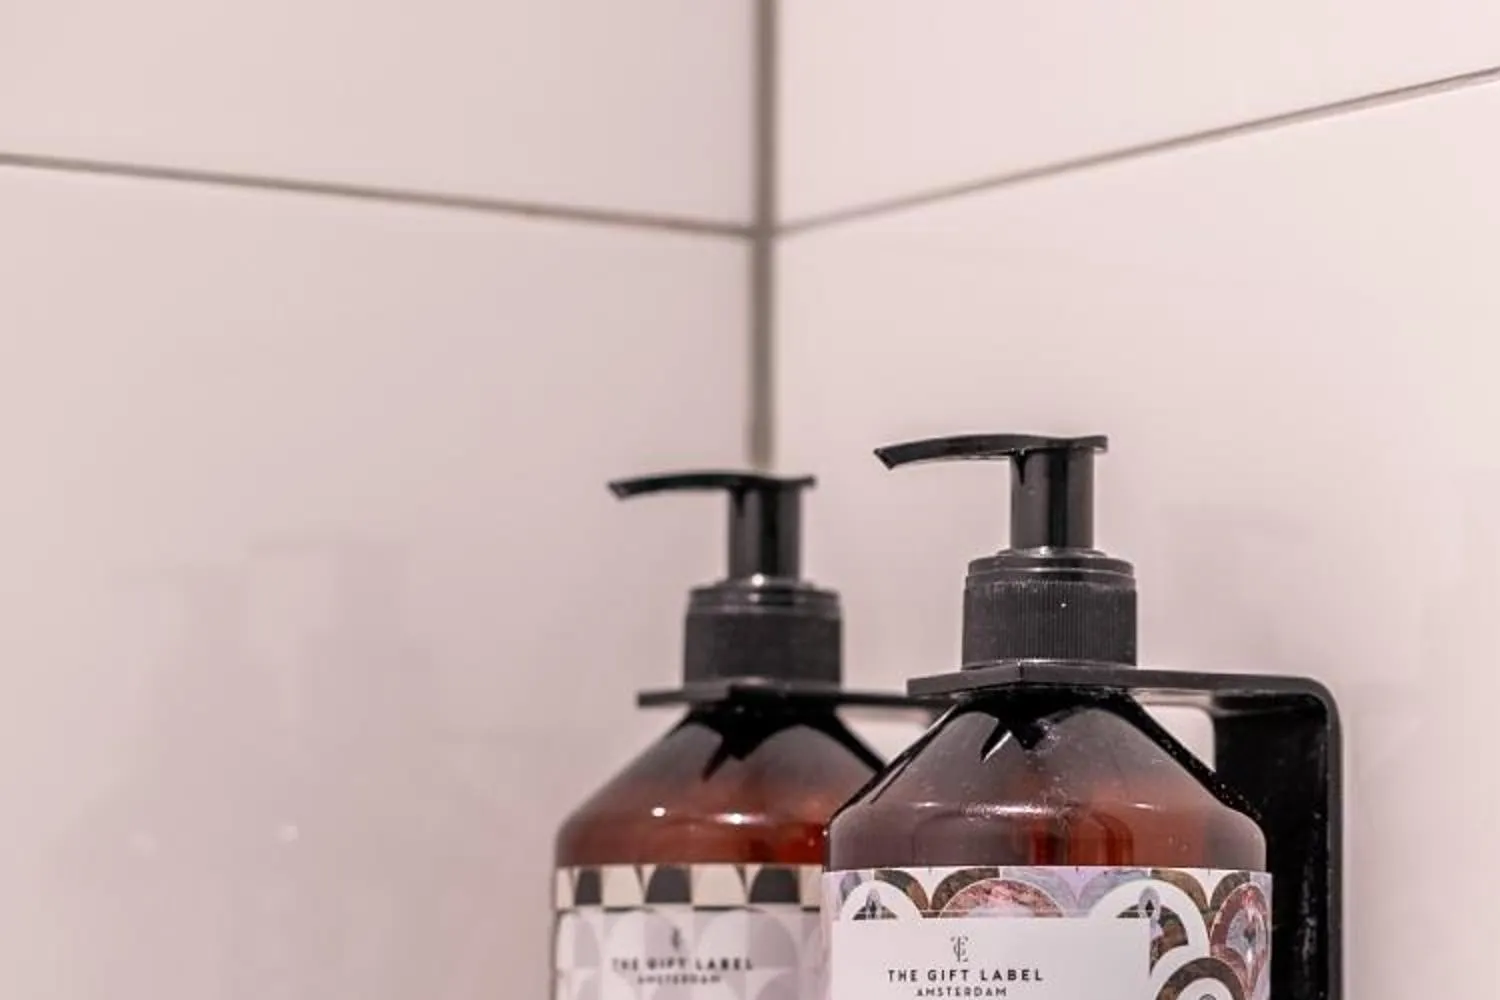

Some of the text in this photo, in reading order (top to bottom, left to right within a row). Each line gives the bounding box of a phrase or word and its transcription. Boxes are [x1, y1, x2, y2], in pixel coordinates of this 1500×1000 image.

[612, 957, 753, 971] THE GIFT LABEL
[888, 969, 1044, 982] THE GIFT LABEL
[916, 987, 1007, 997] AMSTERDAM
